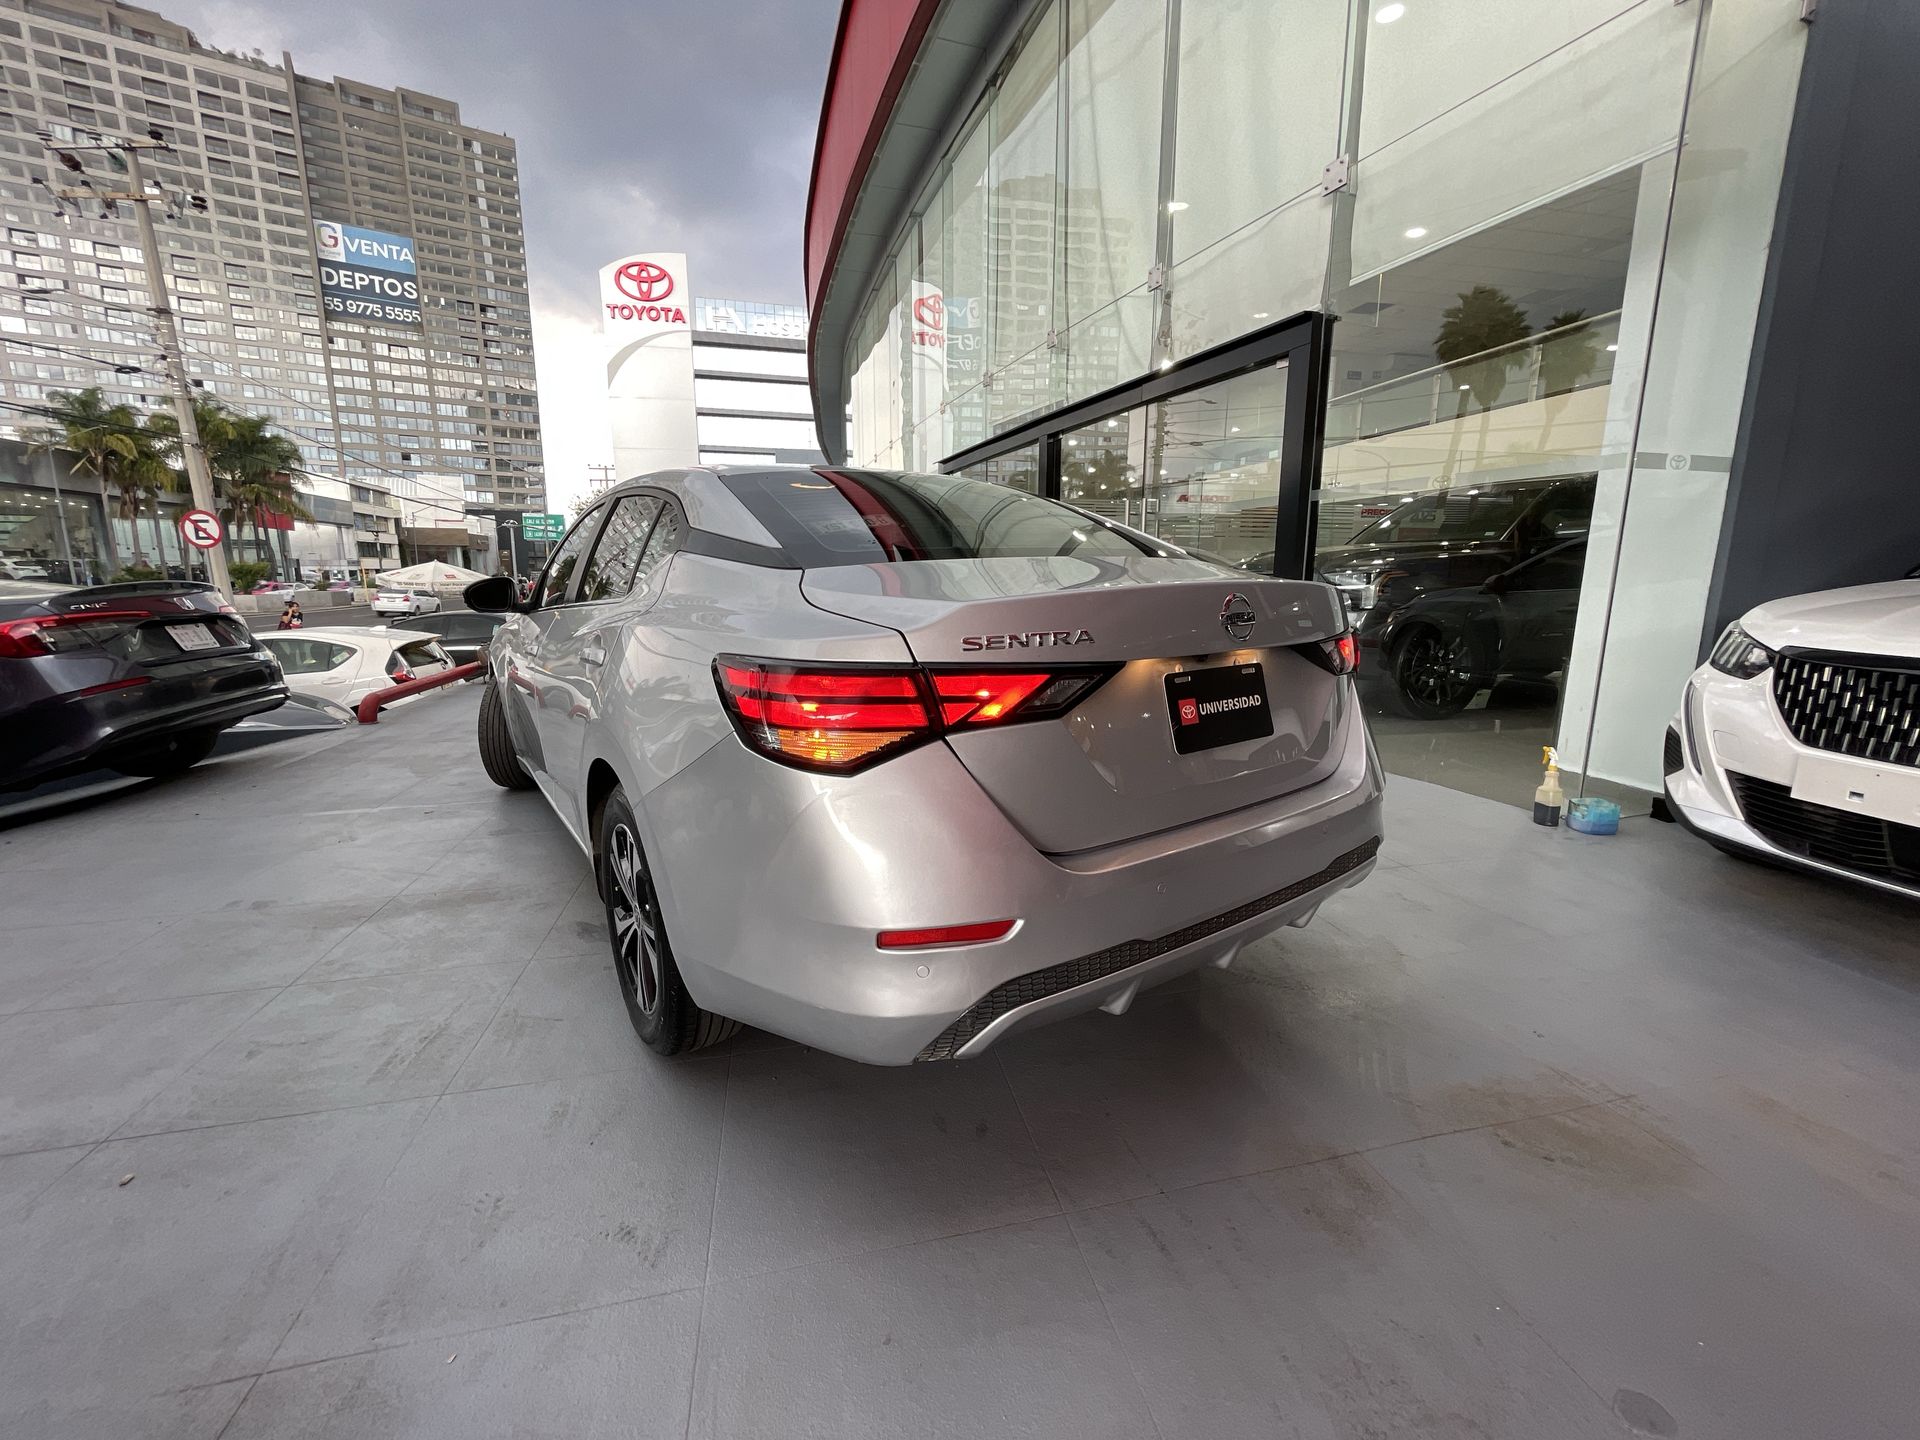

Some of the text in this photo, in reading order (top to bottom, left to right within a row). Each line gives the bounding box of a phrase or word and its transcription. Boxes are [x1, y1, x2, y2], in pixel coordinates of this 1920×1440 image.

[344, 236, 415, 264] VENTA
[320, 266, 418, 300] DEPTOS
[324, 296, 421, 323] 55 9775 5555
[606, 303, 687, 323] TOYOTA
[70, 602, 110, 610] CIVIC
[961, 629, 1095, 651] SENTRA
[1199, 694, 1262, 715] UNIVERSIDAD
